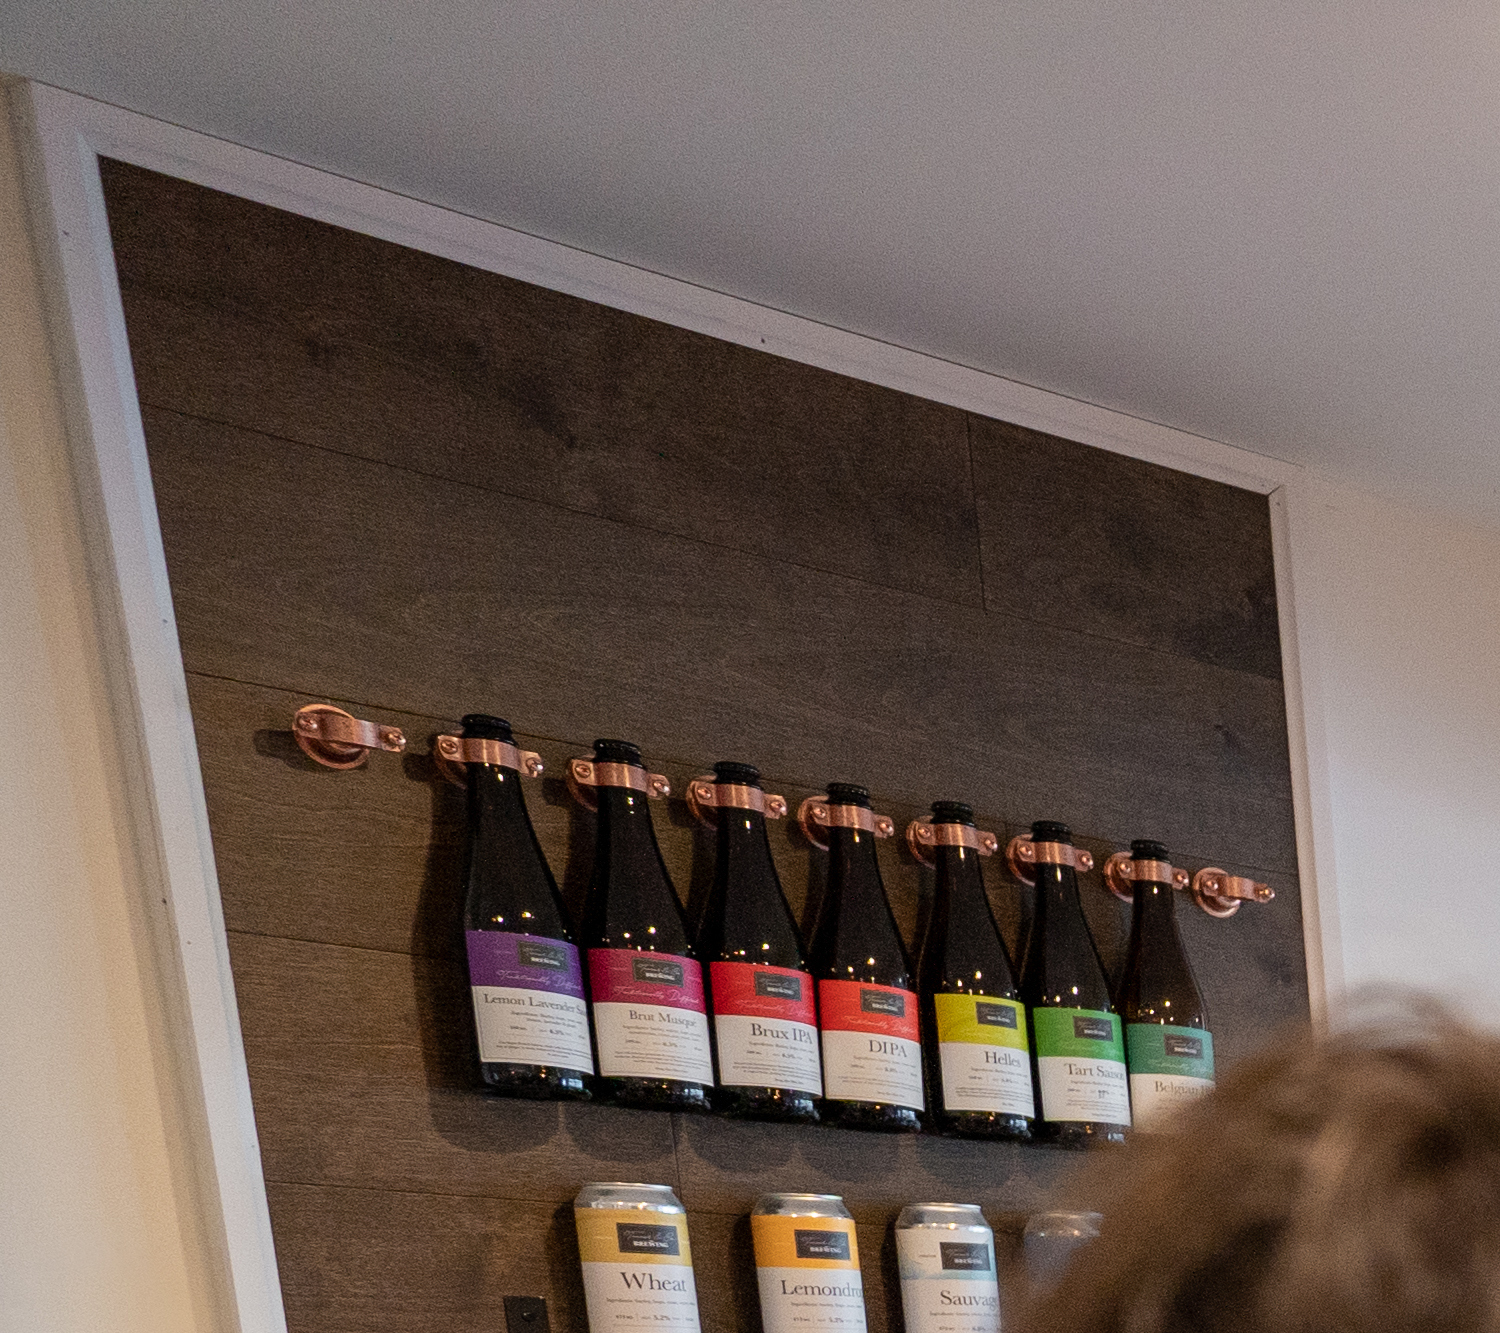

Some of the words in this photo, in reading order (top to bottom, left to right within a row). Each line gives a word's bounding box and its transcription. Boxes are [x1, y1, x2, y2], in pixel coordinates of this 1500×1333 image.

[484, 993, 525, 1007] Lemon
[629, 1009, 655, 1022] Brut
[751, 1022, 789, 1040] Brux
[792, 1027, 814, 1045] IPA
[869, 1039, 908, 1058] DIPA
[1063, 1062, 1094, 1077] Tart
[620, 1271, 688, 1292] Wheat
